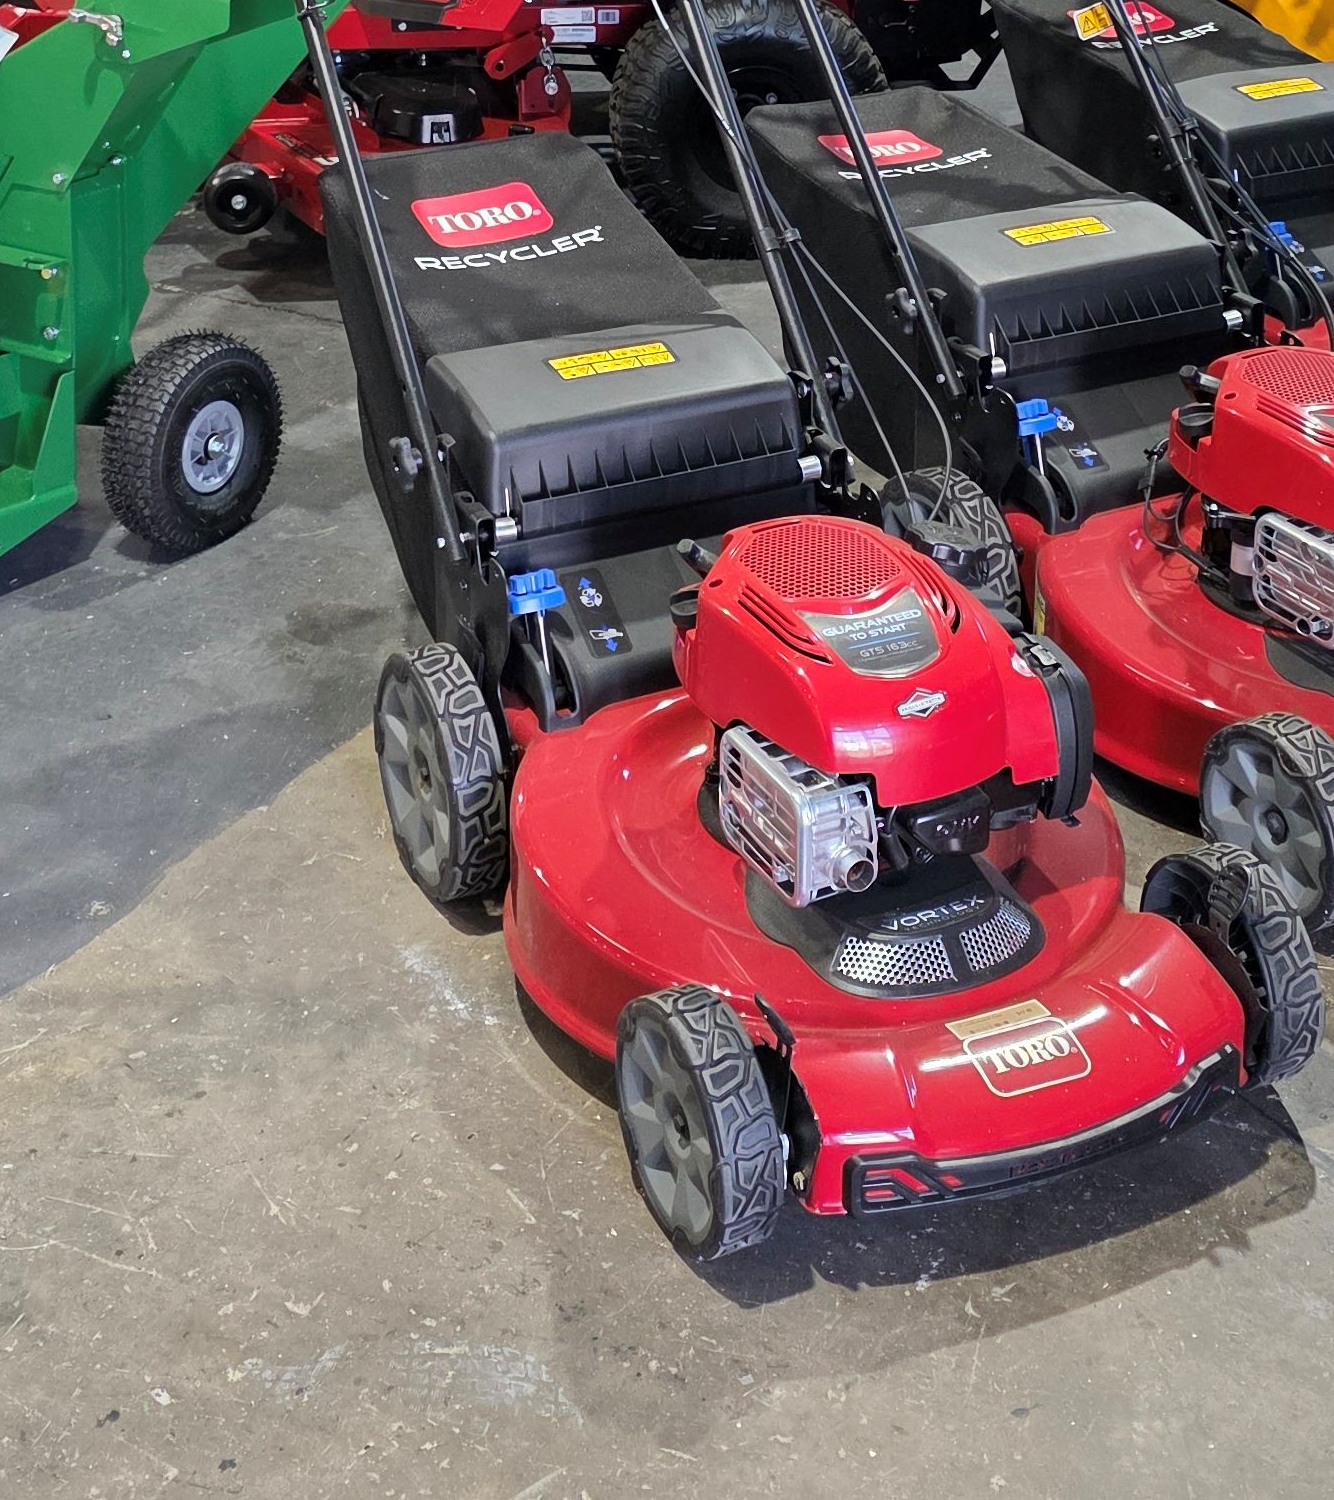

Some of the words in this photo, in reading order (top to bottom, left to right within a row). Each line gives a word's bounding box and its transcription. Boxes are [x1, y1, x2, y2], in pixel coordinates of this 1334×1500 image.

[427, 200, 534, 234] TORO
[413, 225, 605, 271] RECYCLER
[822, 608, 922, 637] GUARANTEED
[849, 631, 867, 641] TO
[868, 622, 907, 638] START
[859, 645, 885, 658] GTS
[886, 639, 919, 652] 163cc
[881, 894, 986, 931] VORTEX
[976, 1034, 1071, 1074] TORO
